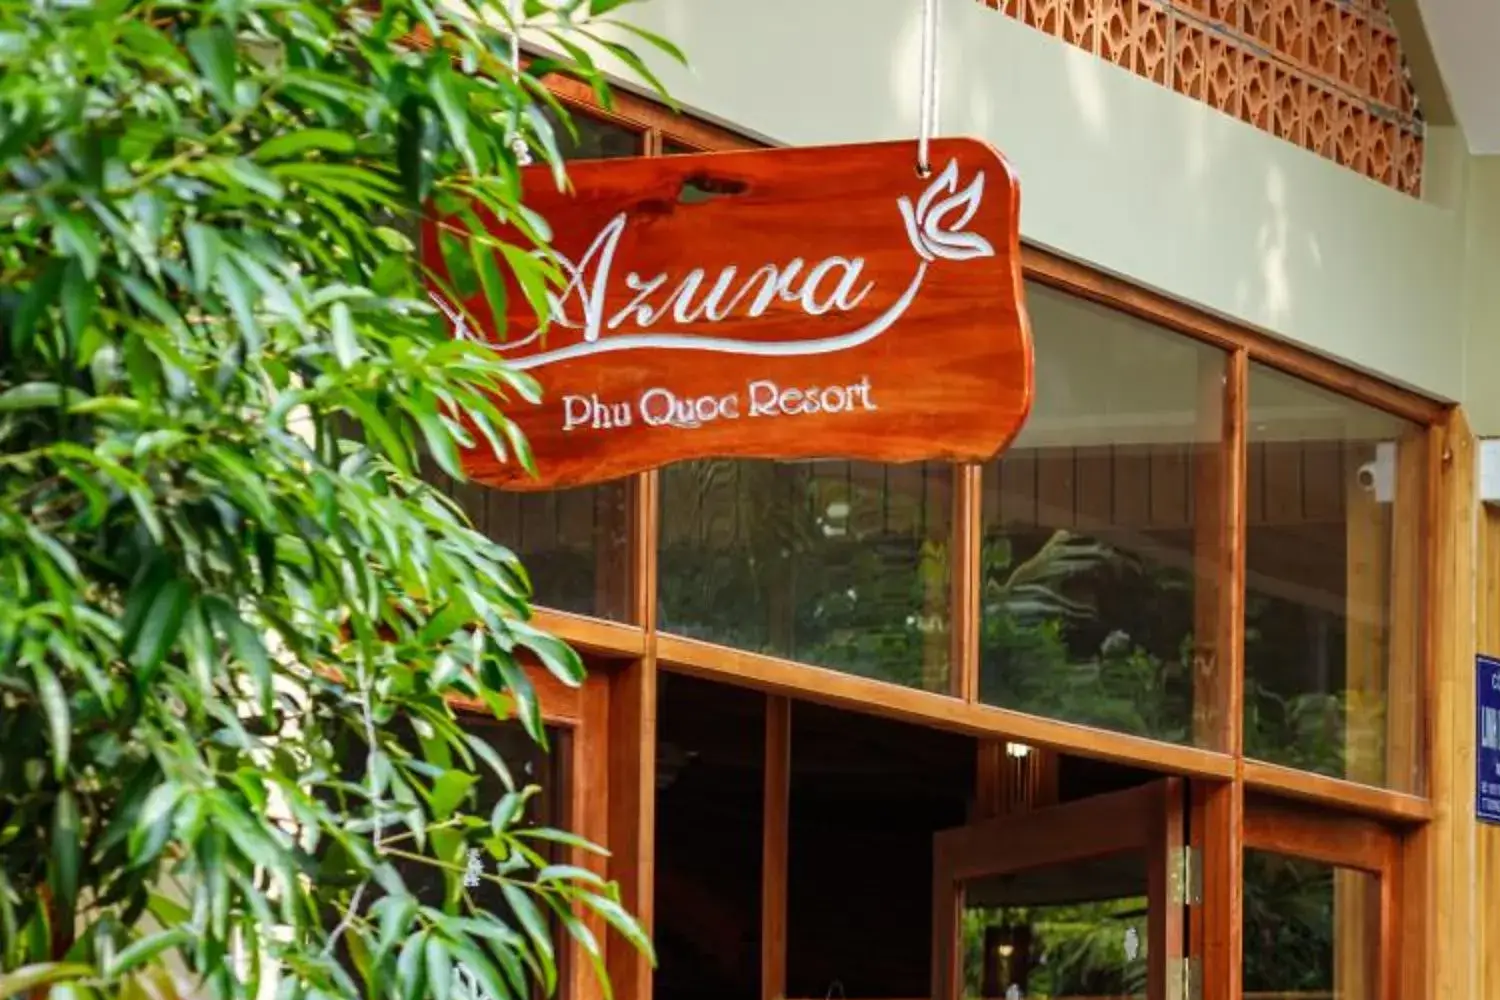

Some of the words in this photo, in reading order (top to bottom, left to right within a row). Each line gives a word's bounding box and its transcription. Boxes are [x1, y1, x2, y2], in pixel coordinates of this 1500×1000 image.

[530, 211, 874, 342] Azura
[563, 394, 632, 431] Phu
[639, 387, 739, 428] Quoc
[747, 376, 878, 417] Resort
